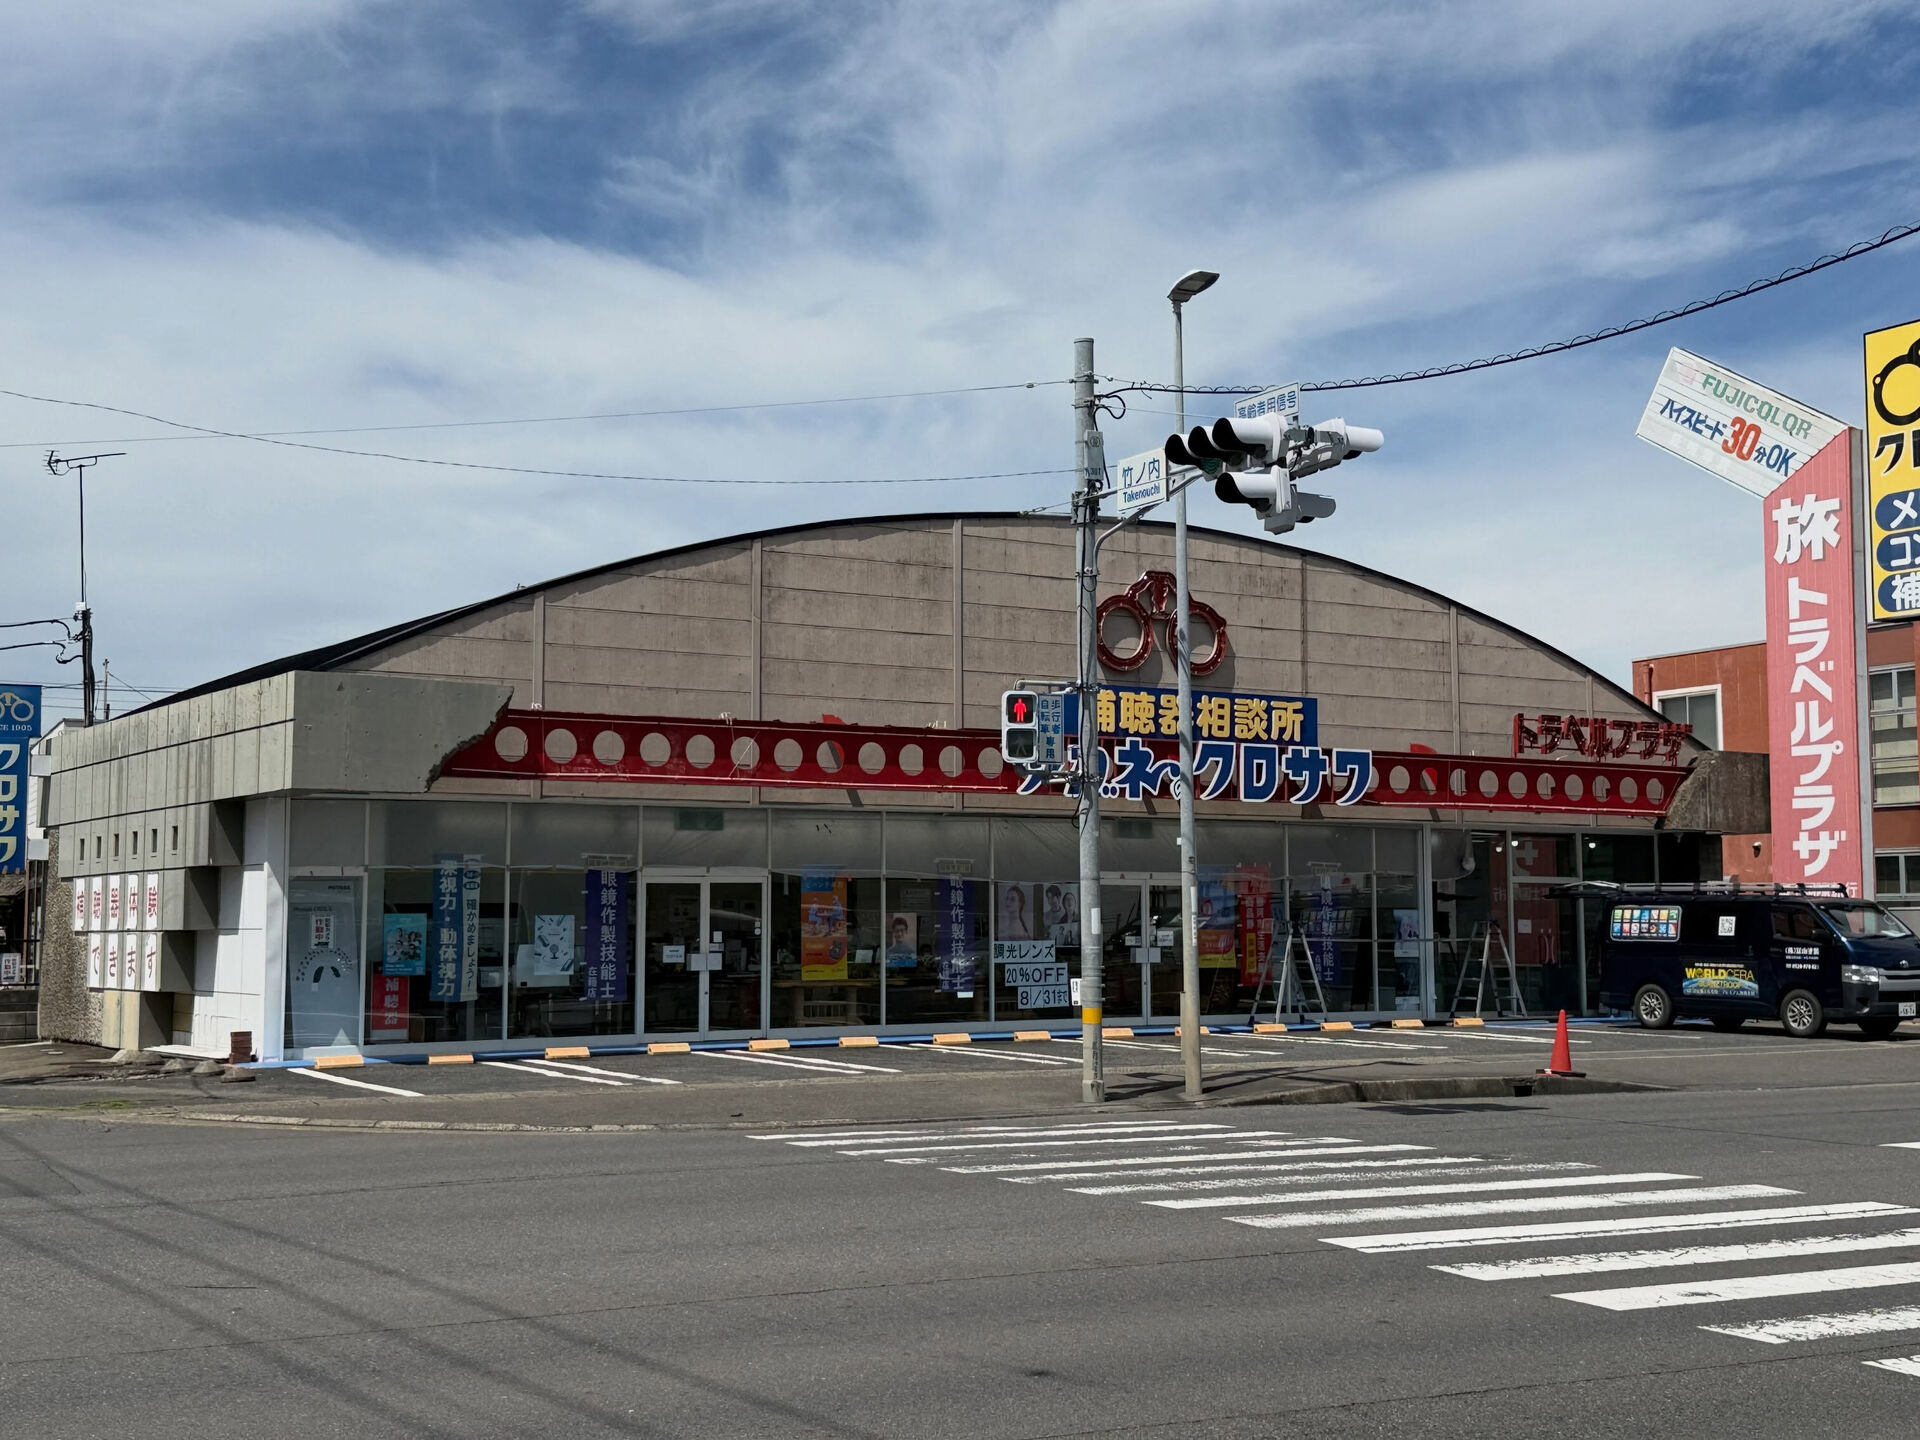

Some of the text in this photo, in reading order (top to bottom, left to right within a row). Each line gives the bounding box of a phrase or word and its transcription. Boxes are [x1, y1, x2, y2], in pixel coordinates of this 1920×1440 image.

[1702, 374, 1812, 440] FUJICOLOR
[1122, 457, 1161, 488] 竹ノ内
[1874, 431, 1920, 475] ク
[1122, 482, 1161, 504] Takenouchi
[1016, 737, 1373, 806] ネクロサワ
[600, 870, 618, 998] 眼鏡作製技能士
[994, 943, 1054, 959] 調光レンズ
